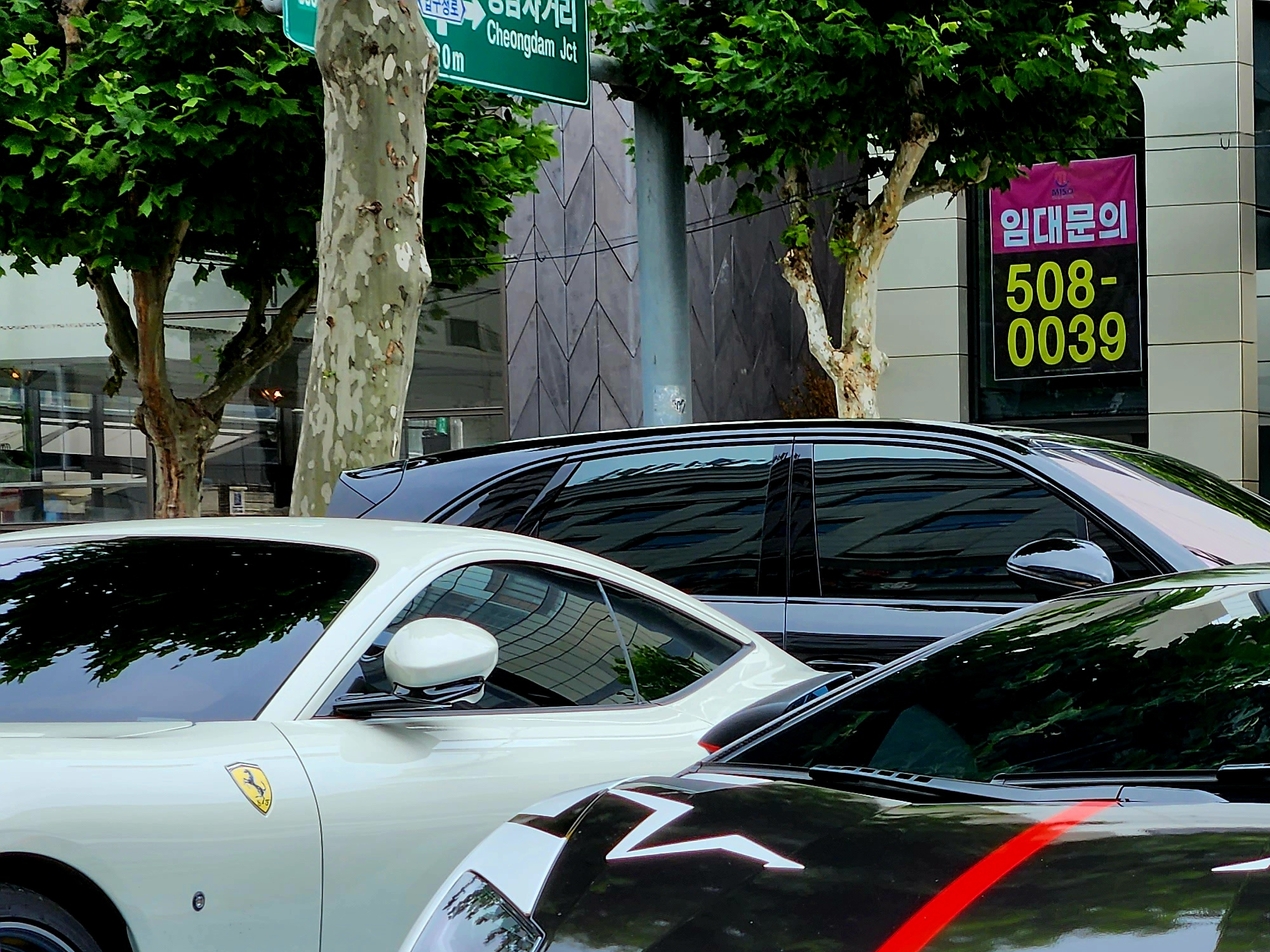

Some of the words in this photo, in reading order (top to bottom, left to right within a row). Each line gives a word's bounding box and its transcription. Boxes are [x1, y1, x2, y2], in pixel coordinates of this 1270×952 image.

[437, 43, 465, 73] 0m
[487, 19, 555, 59] Cheongdam
[559, 36, 578, 63] Jct
[1000, 200, 1128, 247] 임대문의
[1006, 259, 1118, 313] 508-
[1007, 311, 1127, 367] 0039
